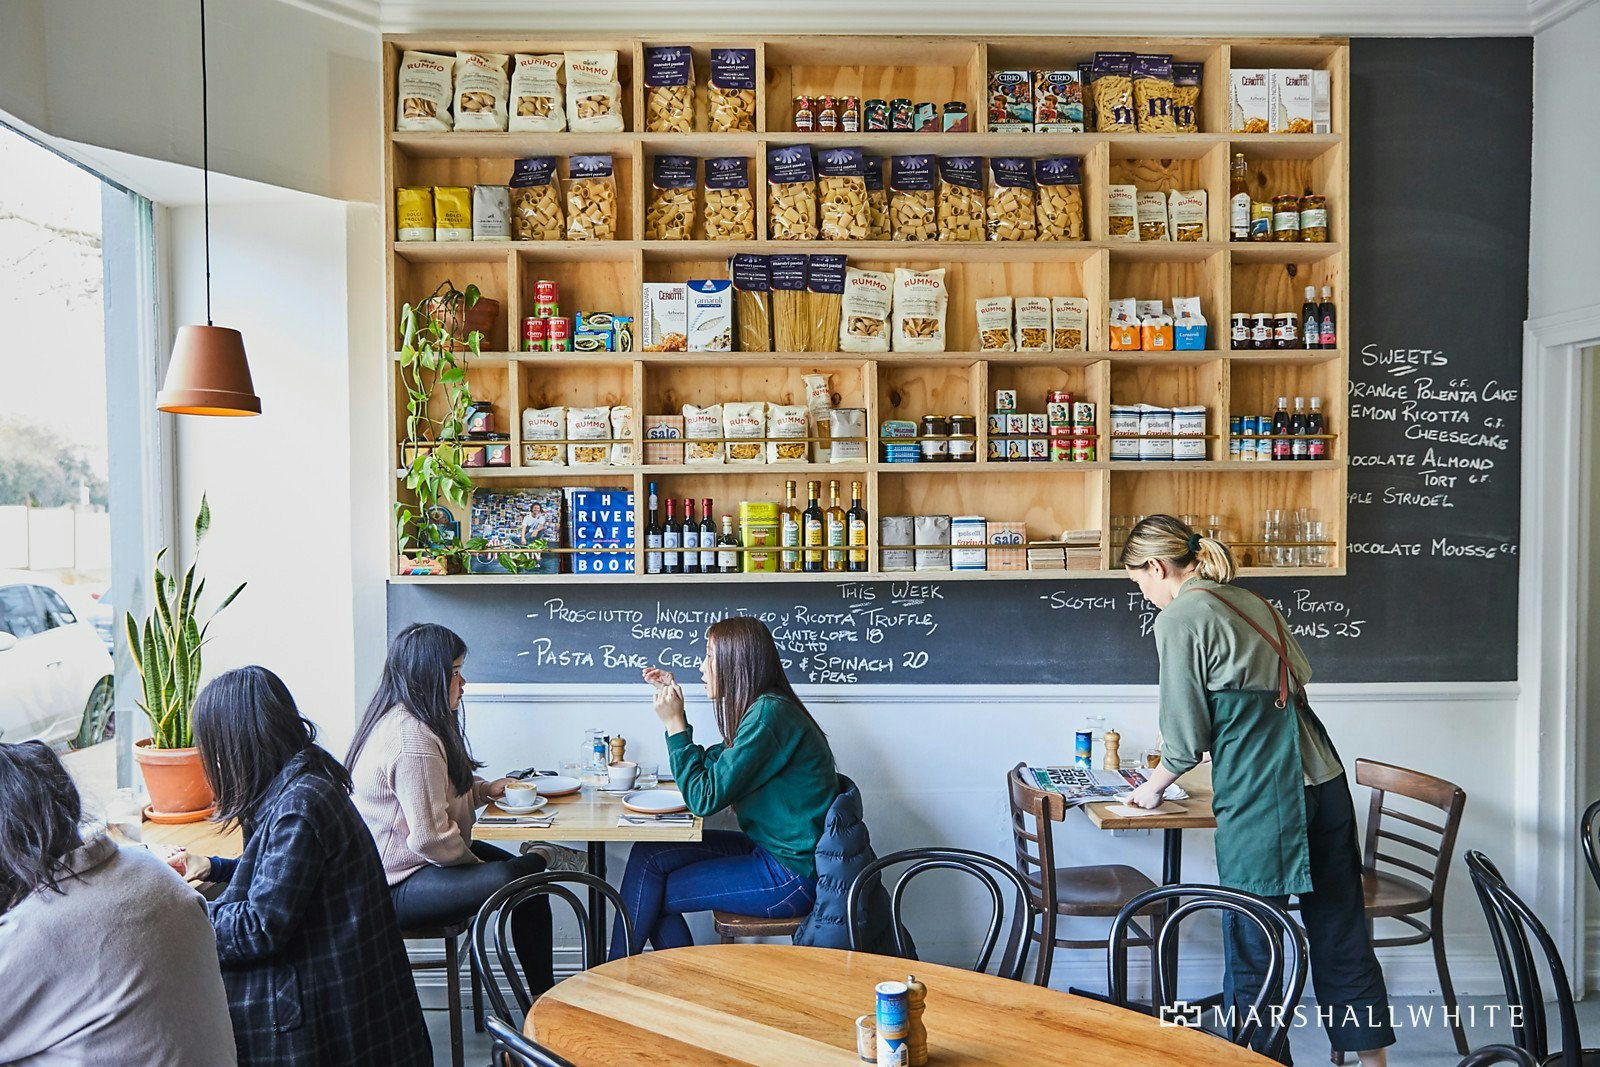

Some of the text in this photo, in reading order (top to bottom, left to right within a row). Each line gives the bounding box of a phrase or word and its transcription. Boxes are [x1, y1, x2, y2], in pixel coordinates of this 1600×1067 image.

[406, 63, 445, 72] RUMMO
[572, 64, 609, 76] RUMMO
[851, 278, 887, 291] RUMMO
[904, 278, 940, 289] RUMMO
[980, 306, 1007, 314] RUMMO
[1021, 305, 1047, 313] RUMMO
[1056, 306, 1082, 314] RUMMO
[1361, 343, 1448, 366] SWEETS
[1414, 377, 1477, 403] POLENTA
[1481, 380, 1518, 402] CAKE
[1350, 400, 1470, 423] EMON RICOTTA
[528, 419, 559, 428] RUMMO
[575, 420, 606, 429] RUMMO
[687, 416, 718, 424] RUMMO
[729, 418, 760, 426] RUMMO
[777, 416, 806, 425] RUMMO
[650, 428, 677, 439] sale
[1404, 424, 1509, 450] CHEESECAKE
[1421, 447, 1494, 471] ALMOND
[1417, 470, 1458, 488] TORT
[578, 494, 635, 506] THE
[1383, 486, 1454, 508] STRUDEL
[578, 510, 635, 522] RIVER
[578, 527, 635, 539] CAFE
[994, 534, 1020, 545] sale
[1346, 542, 1422, 556] HOCOLATE
[1431, 537, 1498, 559] MOUSSE
[578, 559, 635, 571] BOOK
[836, 581, 944, 600] THIS WEEK
[1050, 590, 1116, 610] SCOTCH
[1293, 588, 1351, 617] POTATO,
[544, 598, 643, 623] PROSCIUTTO
[656, 600, 729, 625] INVOLTINI
[794, 605, 856, 631] RICOTTA
[860, 607, 939, 636] TRUFFLE,
[631, 623, 683, 640] SERVED
[771, 625, 884, 644] CANTELOPE 18
[1333, 620, 1367, 638] 25
[532, 637, 594, 667] PASTA
[813, 652, 894, 672] SPINACH
[902, 651, 929, 669] 20
[820, 670, 858, 684] PEAS
